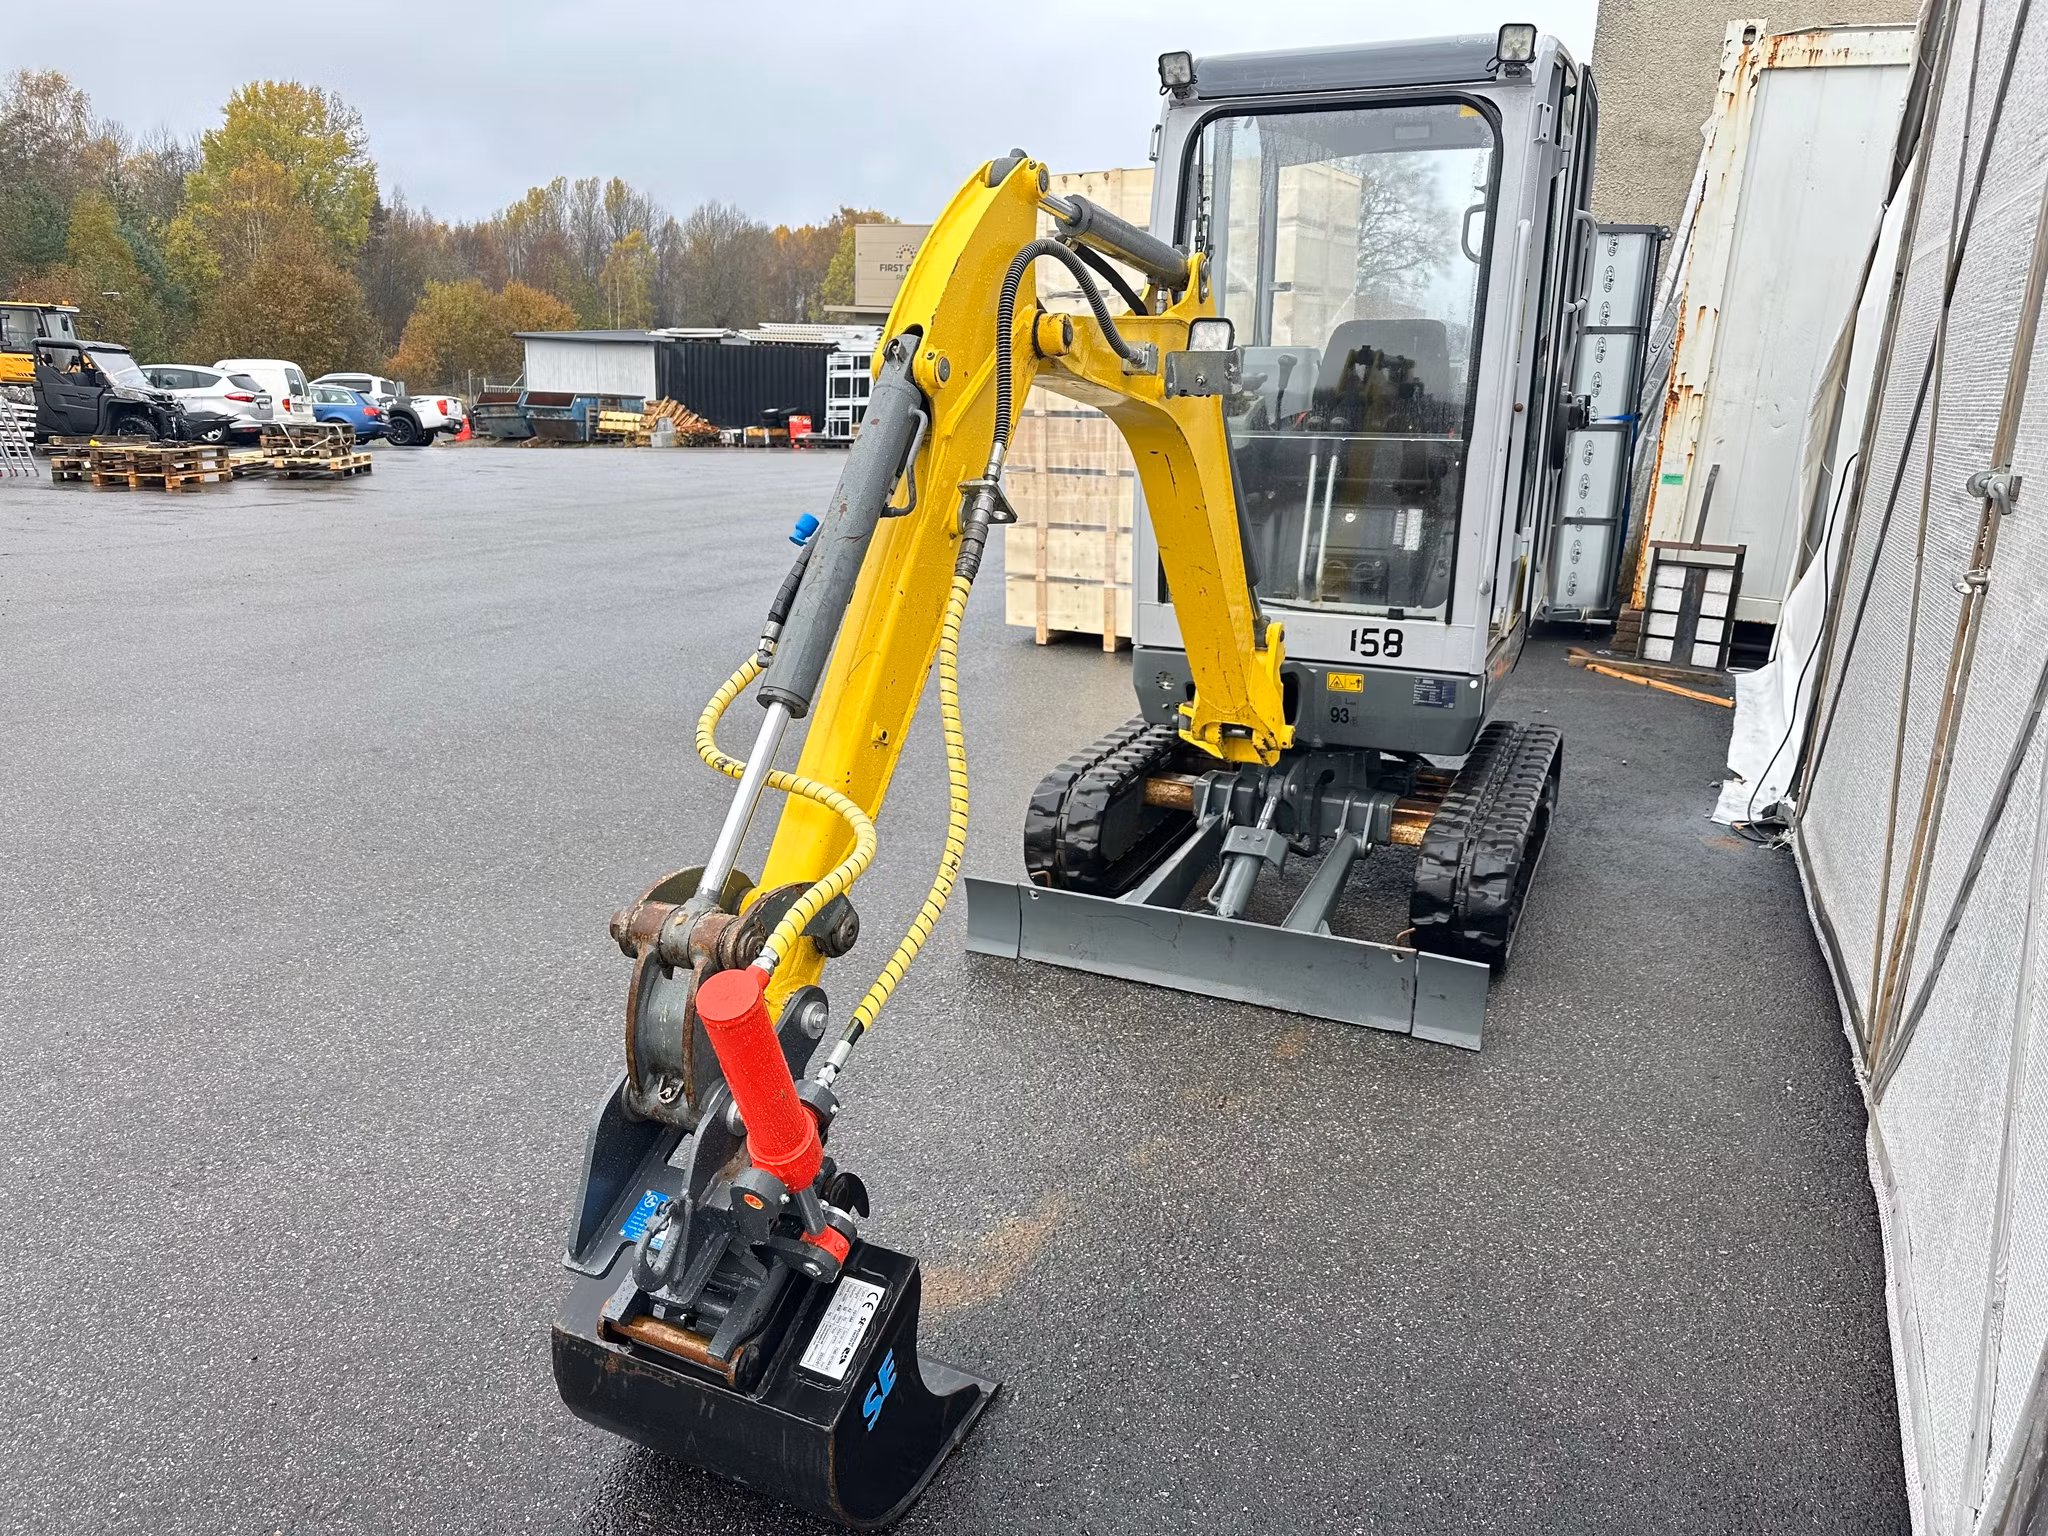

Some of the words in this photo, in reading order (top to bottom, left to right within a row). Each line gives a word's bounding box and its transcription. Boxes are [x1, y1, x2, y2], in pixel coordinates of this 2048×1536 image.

[879, 263, 904, 272] FIRST
[1350, 628, 1404, 658] 158
[1330, 706, 1350, 724] 93
[862, 1292, 878, 1310] CE
[863, 1347, 898, 1432] SE
